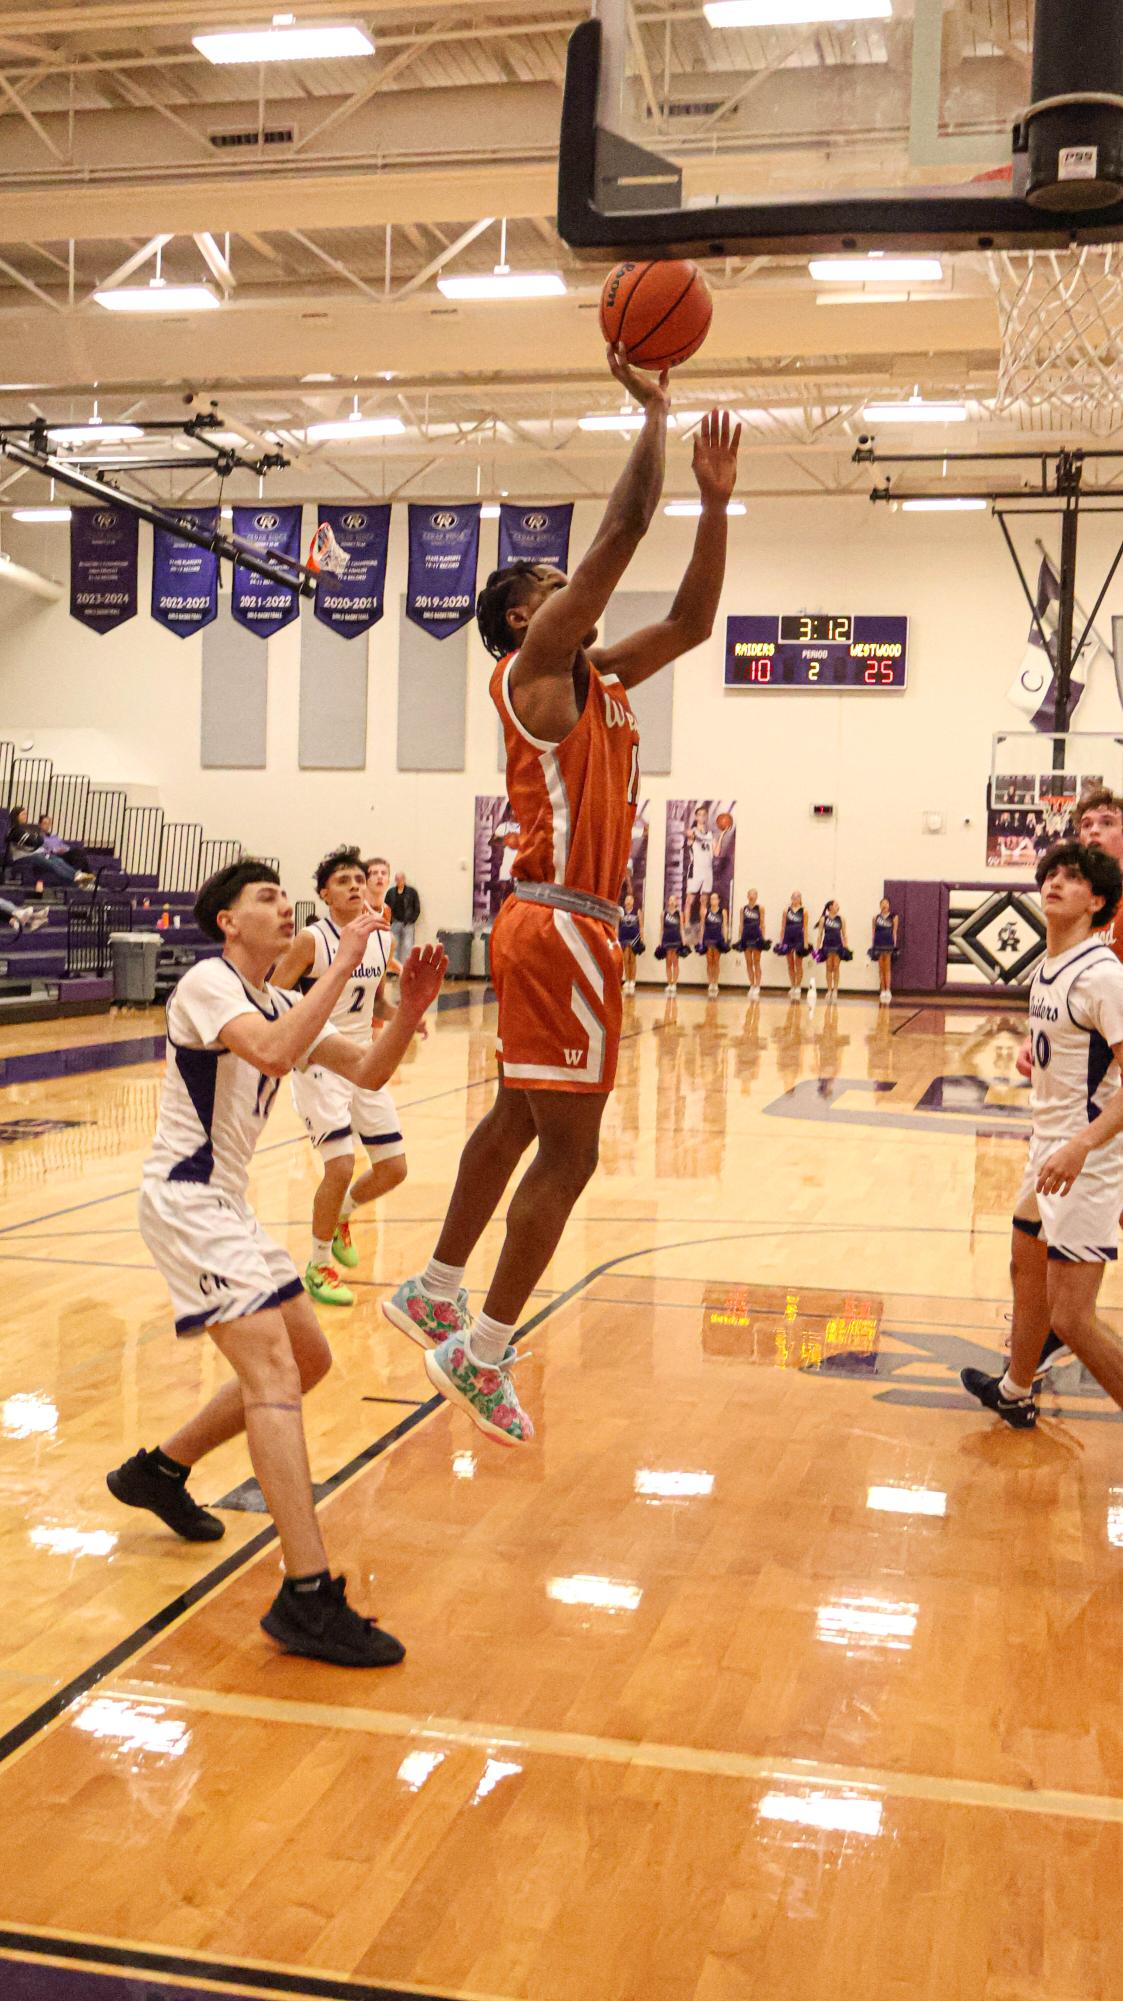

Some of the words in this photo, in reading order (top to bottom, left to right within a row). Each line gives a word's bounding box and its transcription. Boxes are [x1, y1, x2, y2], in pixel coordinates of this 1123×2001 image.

[76, 593, 129, 605] 2023-2024
[160, 596, 210, 609] 2022-2023
[240, 595, 292, 608] 2021-2022
[323, 596, 377, 609] 2020-2021
[415, 595, 470, 608] 2019-2020
[799, 618, 849, 641] 3:12
[734, 643, 776, 657] RAIDERS
[801, 649, 829, 659] PERIOD
[849, 643, 902, 657] WESTWOOD
[751, 659, 771, 682] 10
[808, 661, 820, 681] 2
[864, 660, 894, 683] 25
[347, 985, 365, 1014] 2
[563, 1048, 584, 1067] W
